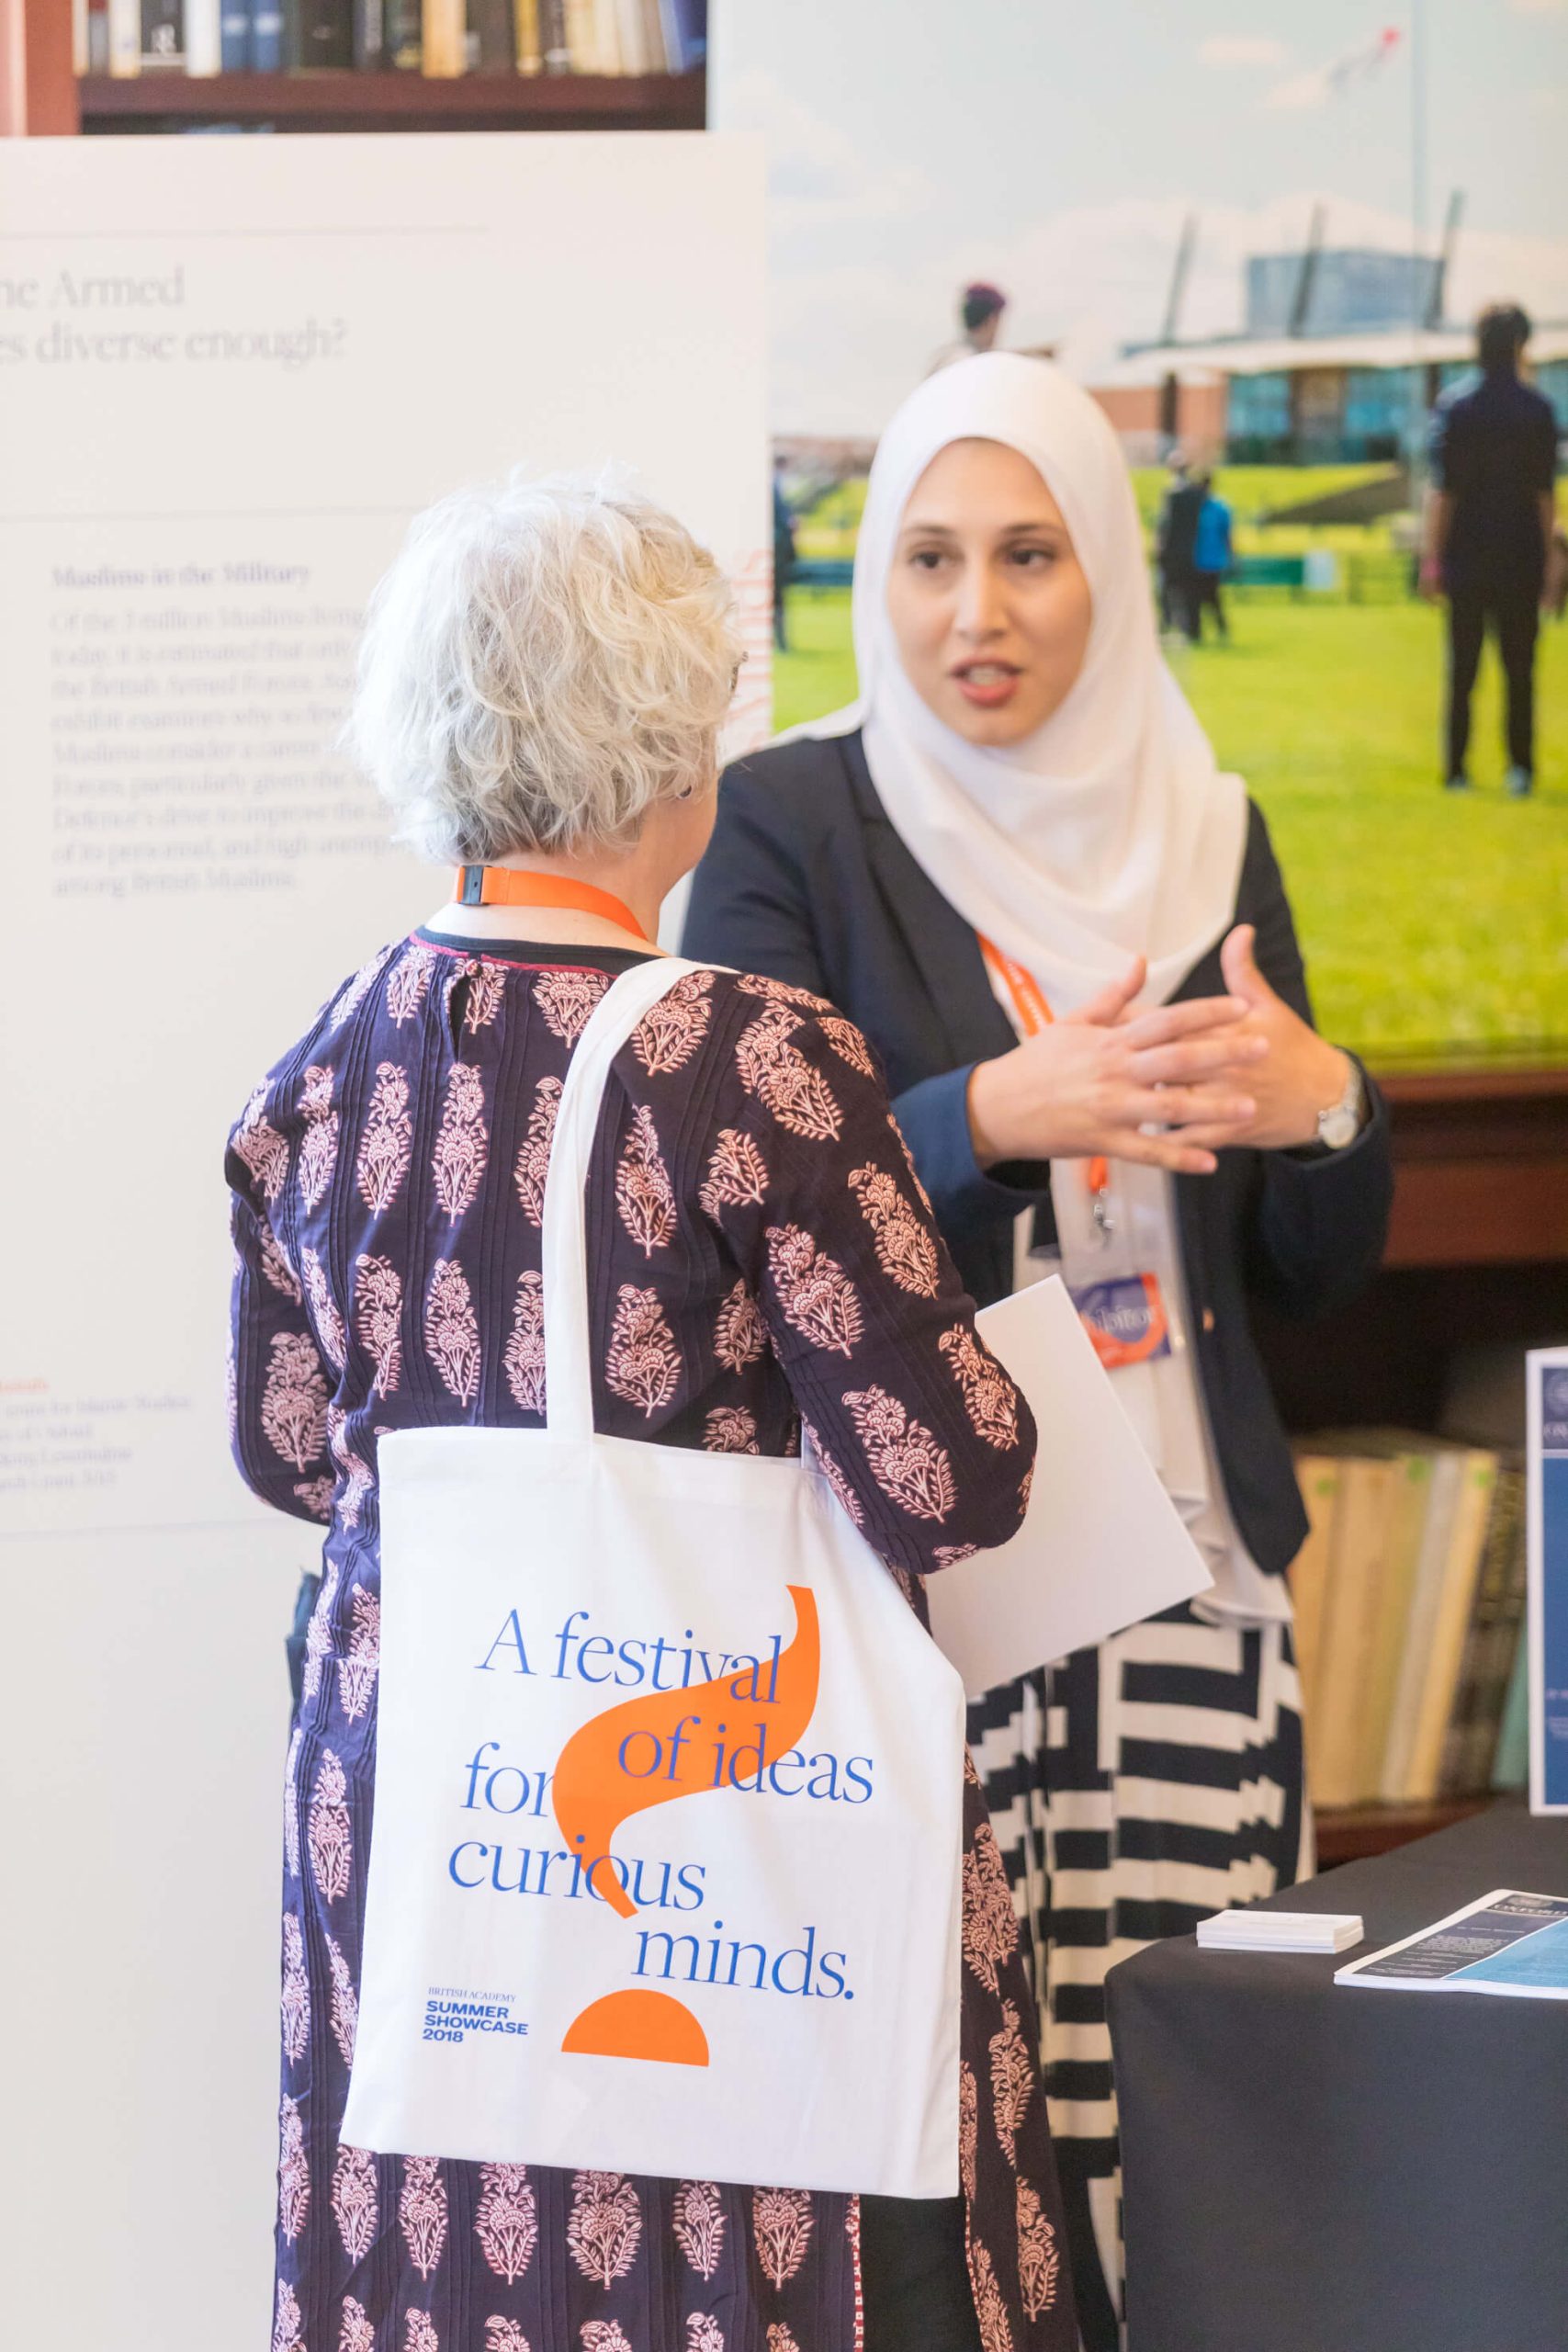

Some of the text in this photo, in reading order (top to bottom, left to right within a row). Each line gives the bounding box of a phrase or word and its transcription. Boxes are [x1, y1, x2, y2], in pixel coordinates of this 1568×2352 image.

[51, 264, 187, 307] Armed
[35, 319, 176, 364] diverse
[184, 315, 348, 372] enough?
[475, 1609, 783, 1703] A festival
[459, 1742, 554, 1817] for
[617, 1715, 874, 1804] of ideas
[448, 1834, 706, 1911] curious
[630, 1920, 855, 2001] minds.
[426, 2000, 509, 2018] SUMMER
[428, 1986, 516, 2002] BRITISH ACADEMY
[422, 2028, 464, 2042] 2018
[424, 2014, 528, 2035] SHOWCASE
